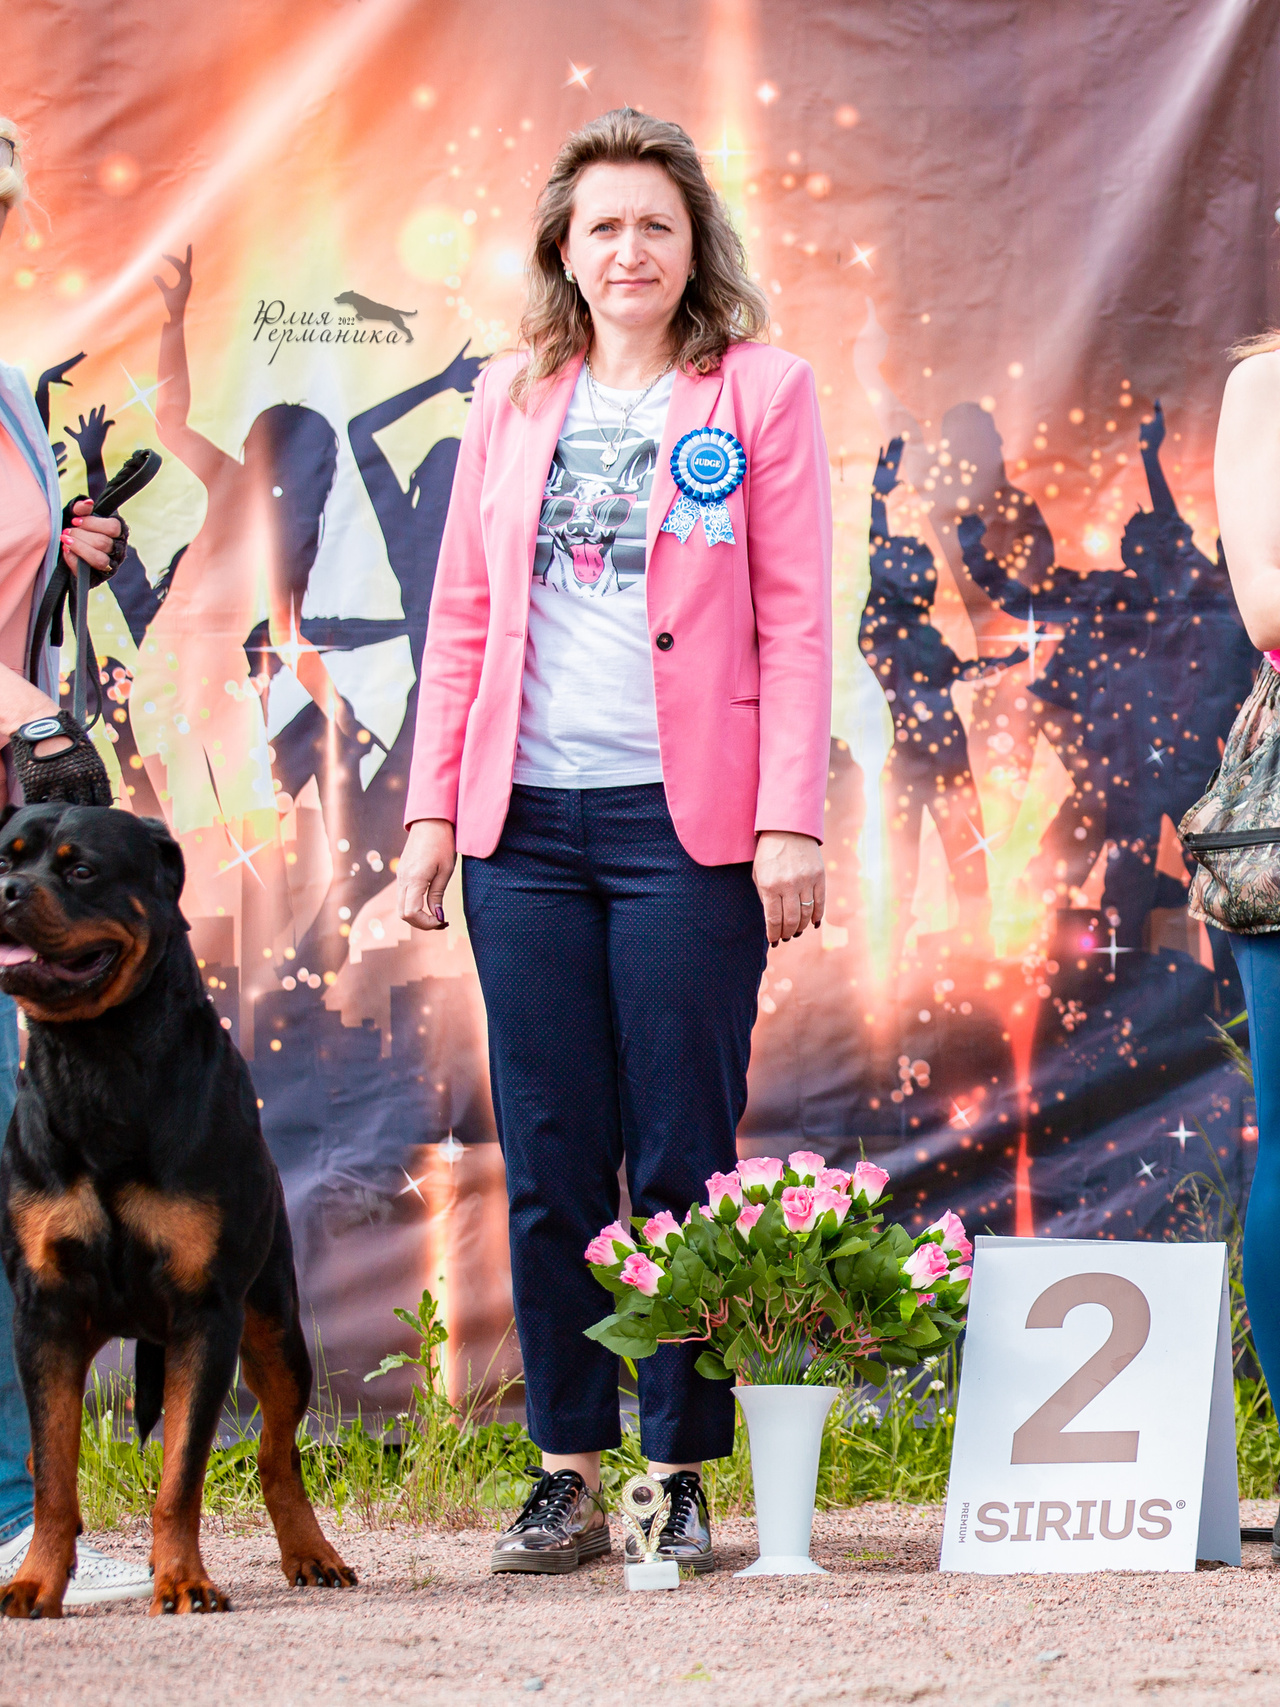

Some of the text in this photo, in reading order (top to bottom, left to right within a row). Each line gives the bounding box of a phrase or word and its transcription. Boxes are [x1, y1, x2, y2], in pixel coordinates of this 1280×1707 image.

[694, 457, 721, 468] JUDGE
[1009, 1271, 1152, 1466] 2
[958, 1502, 970, 1544] PREMIUM
